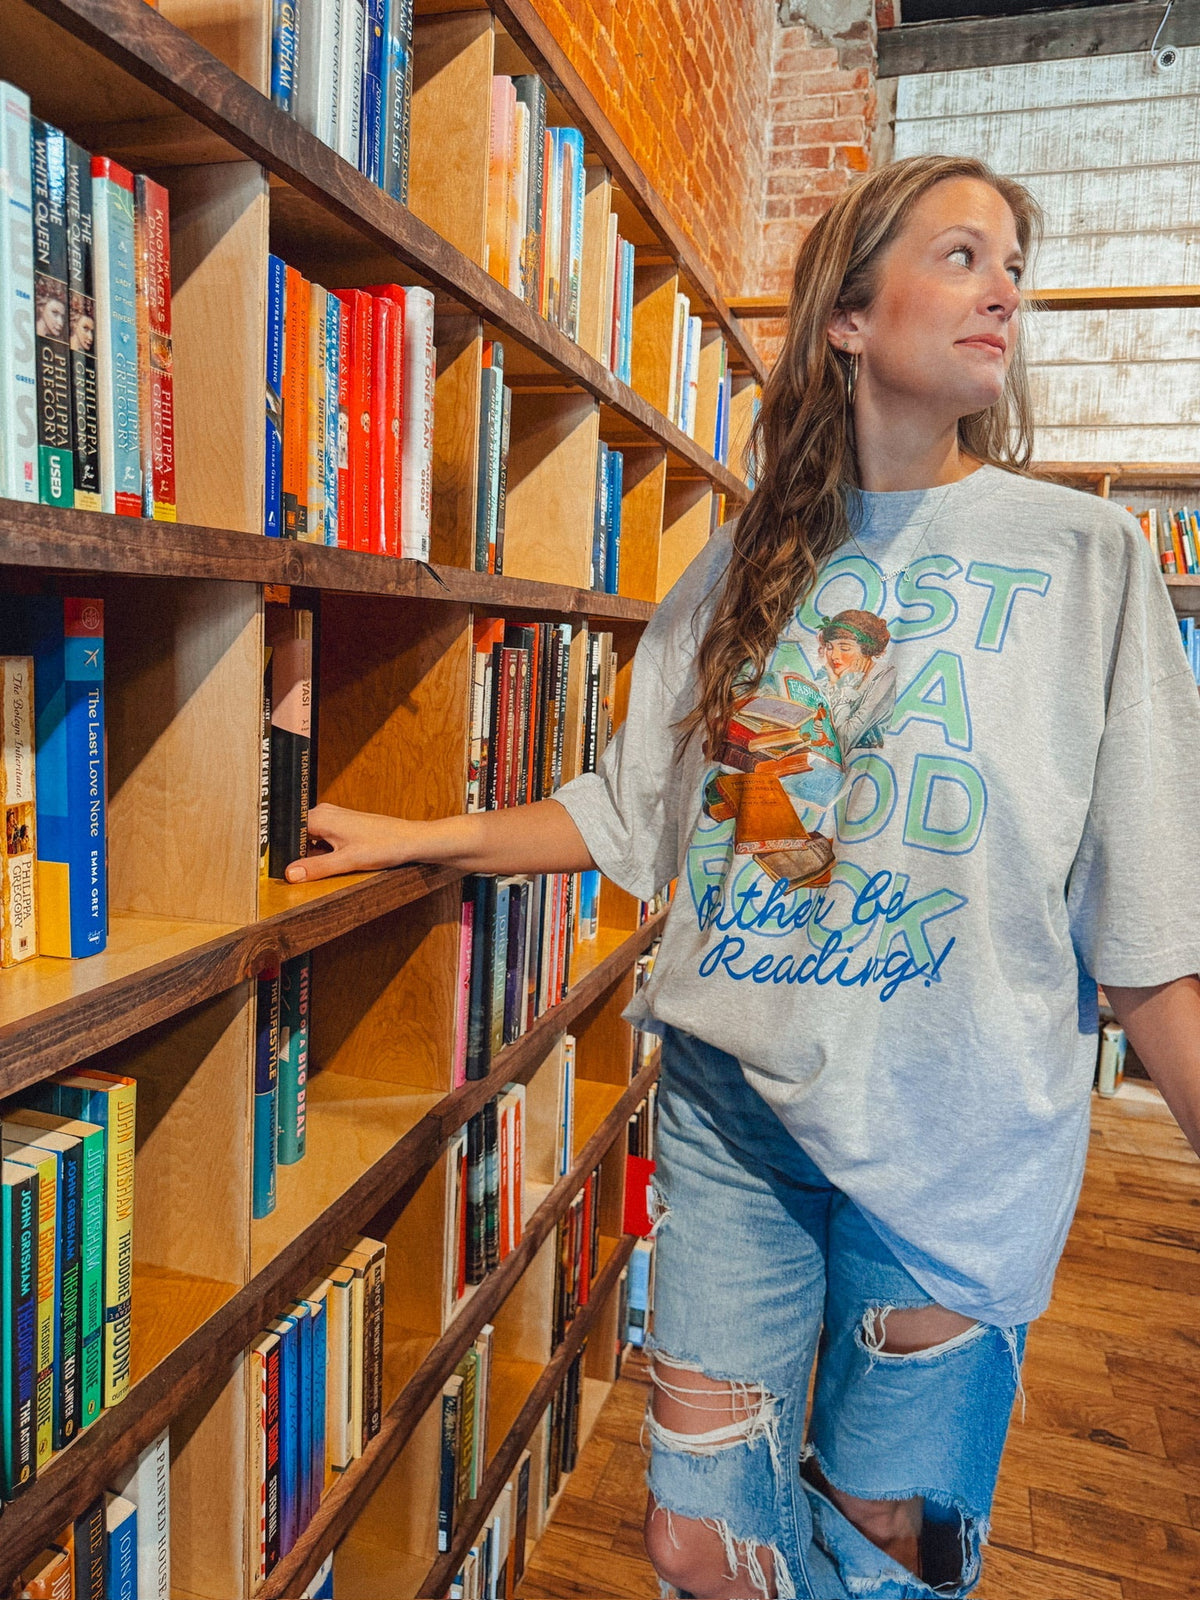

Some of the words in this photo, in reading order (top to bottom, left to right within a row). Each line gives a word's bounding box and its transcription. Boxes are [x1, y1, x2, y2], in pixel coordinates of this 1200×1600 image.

[279, 3, 295, 89] GRISHAM
[354, 8, 363, 56] JOHN
[331, 45, 340, 126] GRISHAM
[350, 61, 360, 140] GRISHAM
[392, 66, 405, 132] JUDGE'S
[374, 115, 382, 167] Grisham
[391, 133, 402, 169] LIST
[537, 119, 545, 153] FOUR
[35, 139, 48, 198] WHITE
[68, 164, 80, 220] WHITE
[536, 156, 544, 194] WINDS
[36, 202, 50, 264] QUEEN
[70, 224, 82, 282] QUEEN
[82, 214, 92, 246] THE
[148, 216, 159, 308] DAUGHTER
[155, 208, 167, 323] KINGMAKER'S
[272, 324, 280, 383] EVERYTHING
[341, 314, 350, 360] Marley
[424, 326, 432, 358] THE
[339, 376, 348, 401] Me
[341, 362, 348, 375] &
[43, 346, 56, 446] GREGORY
[55, 354, 68, 447] PHILIPPA
[76, 361, 88, 457] GREGORY
[85, 368, 97, 456] PHILIPPA
[116, 352, 129, 454] GREGORY
[126, 358, 138, 453] PHILIPPA
[152, 382, 163, 475] GREGORY
[162, 390, 173, 474] PHILIPPA
[423, 409, 431, 449] MAN
[51, 455, 62, 499] USED
[423, 463, 431, 519] ANDREW
[499, 463, 508, 510] ACTION
[797, 553, 1052, 652] OST
[12, 672, 23, 696] The
[88, 687, 100, 718] The
[12, 698, 24, 737] Boleyn
[88, 722, 100, 757] Last
[14, 738, 25, 799] Inheritance
[88, 759, 100, 797] Love
[261, 737, 270, 797] WAKING
[300, 748, 309, 826] TRANSCENDENT
[89, 800, 100, 838] Note
[259, 800, 269, 845] LIONS
[22, 860, 32, 922] PHILIPPA
[90, 850, 99, 885] EMMA
[13, 864, 23, 929] GREGORY
[91, 887, 99, 918] GREY
[851, 869, 919, 926] be
[498, 914, 506, 957] JOHN
[270, 980, 278, 1007] THE
[299, 965, 309, 1017] KIND
[496, 959, 505, 1002] HART
[698, 930, 957, 1003] Reading!
[269, 1007, 278, 1082] LIFESTYLE
[299, 1018, 307, 1035] OF
[299, 1038, 306, 1049] A
[297, 1051, 307, 1087] BIG
[117, 1100, 134, 1145] JOHN
[295, 1091, 307, 1139] DEAL
[68, 1159, 77, 1199] JOHN
[86, 1148, 99, 1193] JOHN
[116, 1148, 134, 1223] GRISHAM
[21, 1189, 32, 1229] JOHN
[39, 1177, 56, 1226] JOHN
[66, 1198, 77, 1262] GRISHAM
[86, 1194, 101, 1272] GRISHAM
[20, 1229, 32, 1297] GRISHAM
[37, 1226, 55, 1306] GRISHAM
[117, 1230, 131, 1303] THEODORE
[63, 1261, 79, 1330] THEODORE
[88, 1280, 98, 1331] THEODORE
[17, 1296, 34, 1371] THEODORE
[40, 1314, 51, 1368] THEODORE
[112, 1315, 130, 1388] BOONE
[63, 1354, 76, 1381] KID
[85, 1336, 99, 1394] BOONE
[268, 1350, 279, 1424] MAXWELL'S
[19, 1399, 31, 1427] THE
[36, 1376, 51, 1432] BOONE
[268, 1422, 279, 1471] DEMON
[156, 1452, 168, 1532] PAINTED
[269, 1474, 278, 1515] STEVEN
[89, 1508, 103, 1554] THE
[268, 1511, 277, 1543] HALL
[119, 1529, 132, 1580] JOHN
[157, 1534, 168, 1597] HOUSE
